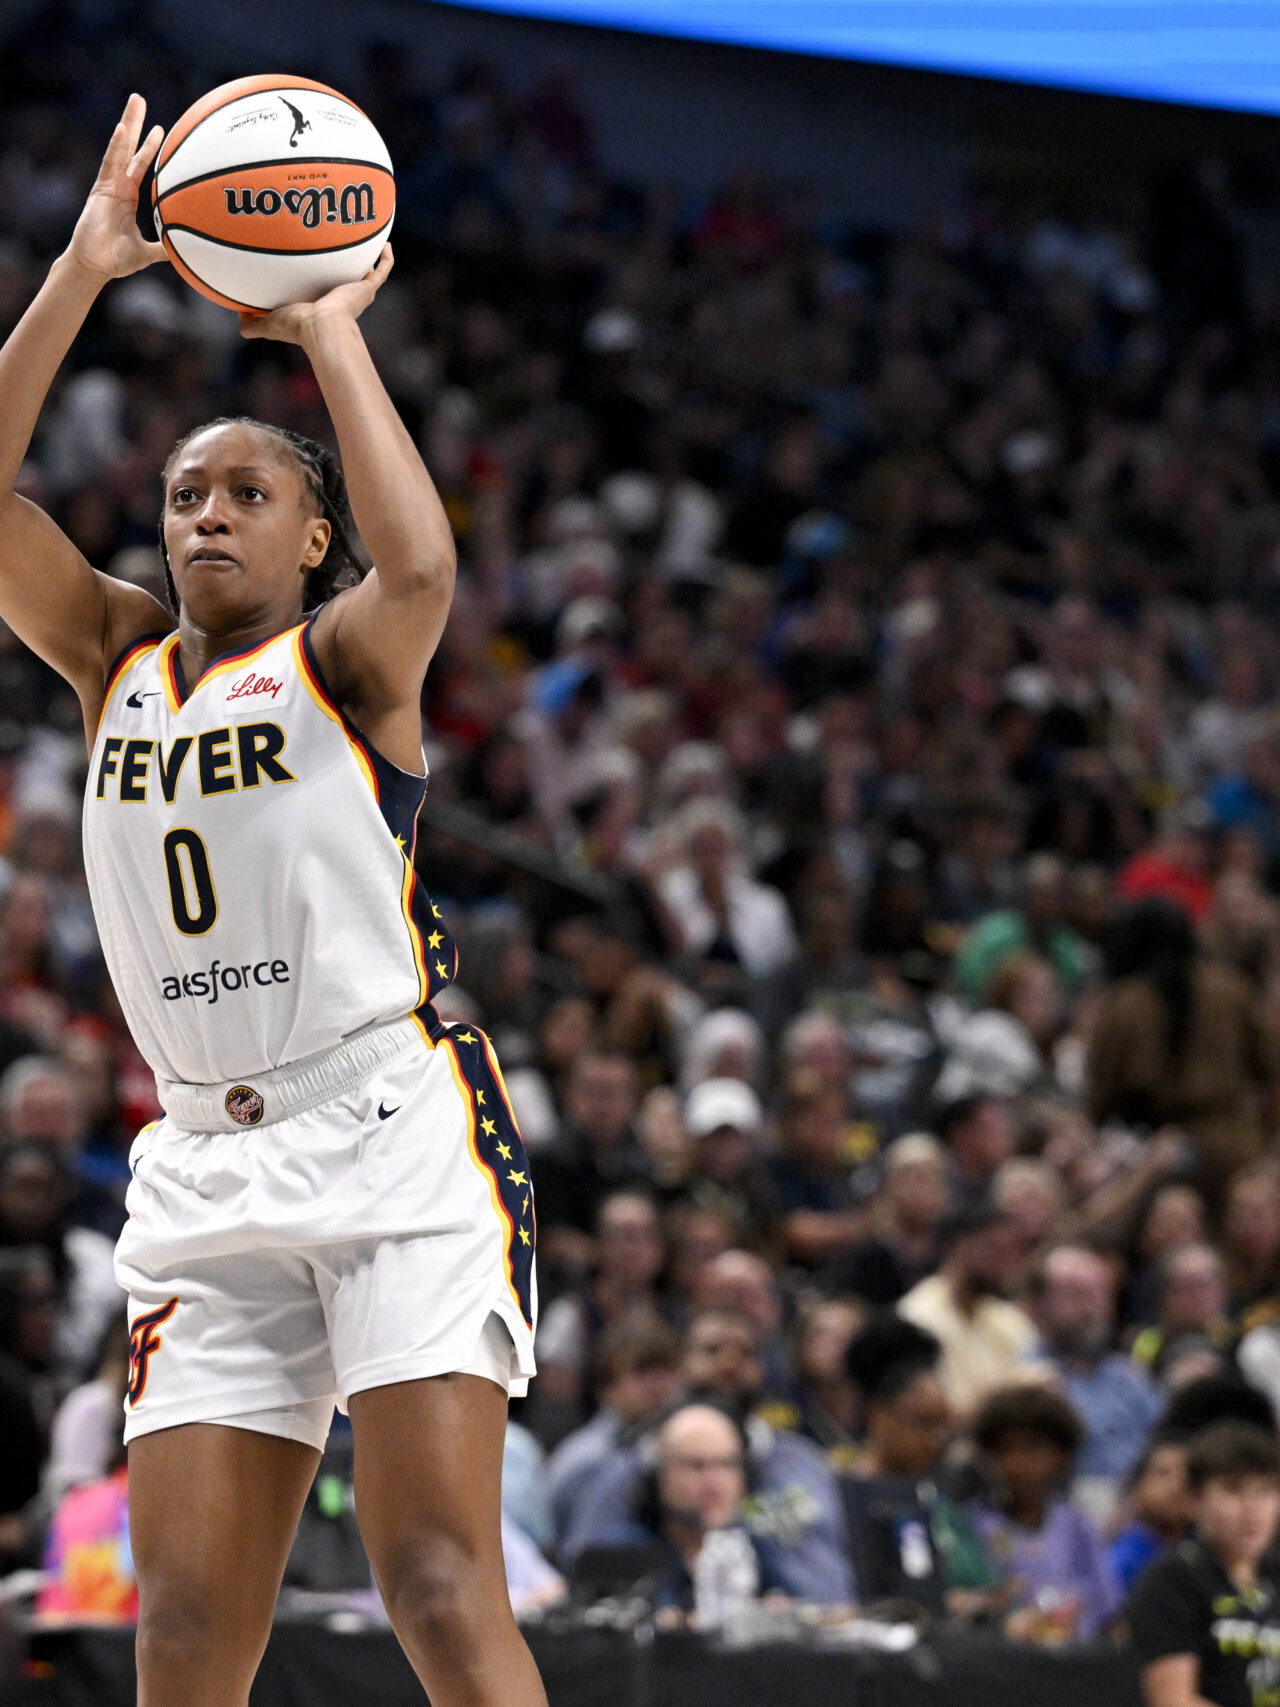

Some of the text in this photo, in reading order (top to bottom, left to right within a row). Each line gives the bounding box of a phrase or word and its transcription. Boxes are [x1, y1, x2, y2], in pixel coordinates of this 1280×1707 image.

[224, 181, 376, 229] Wilson
[226, 673, 284, 701] Lilly
[96, 721, 298, 804] FEVER
[163, 827, 219, 937] 0
